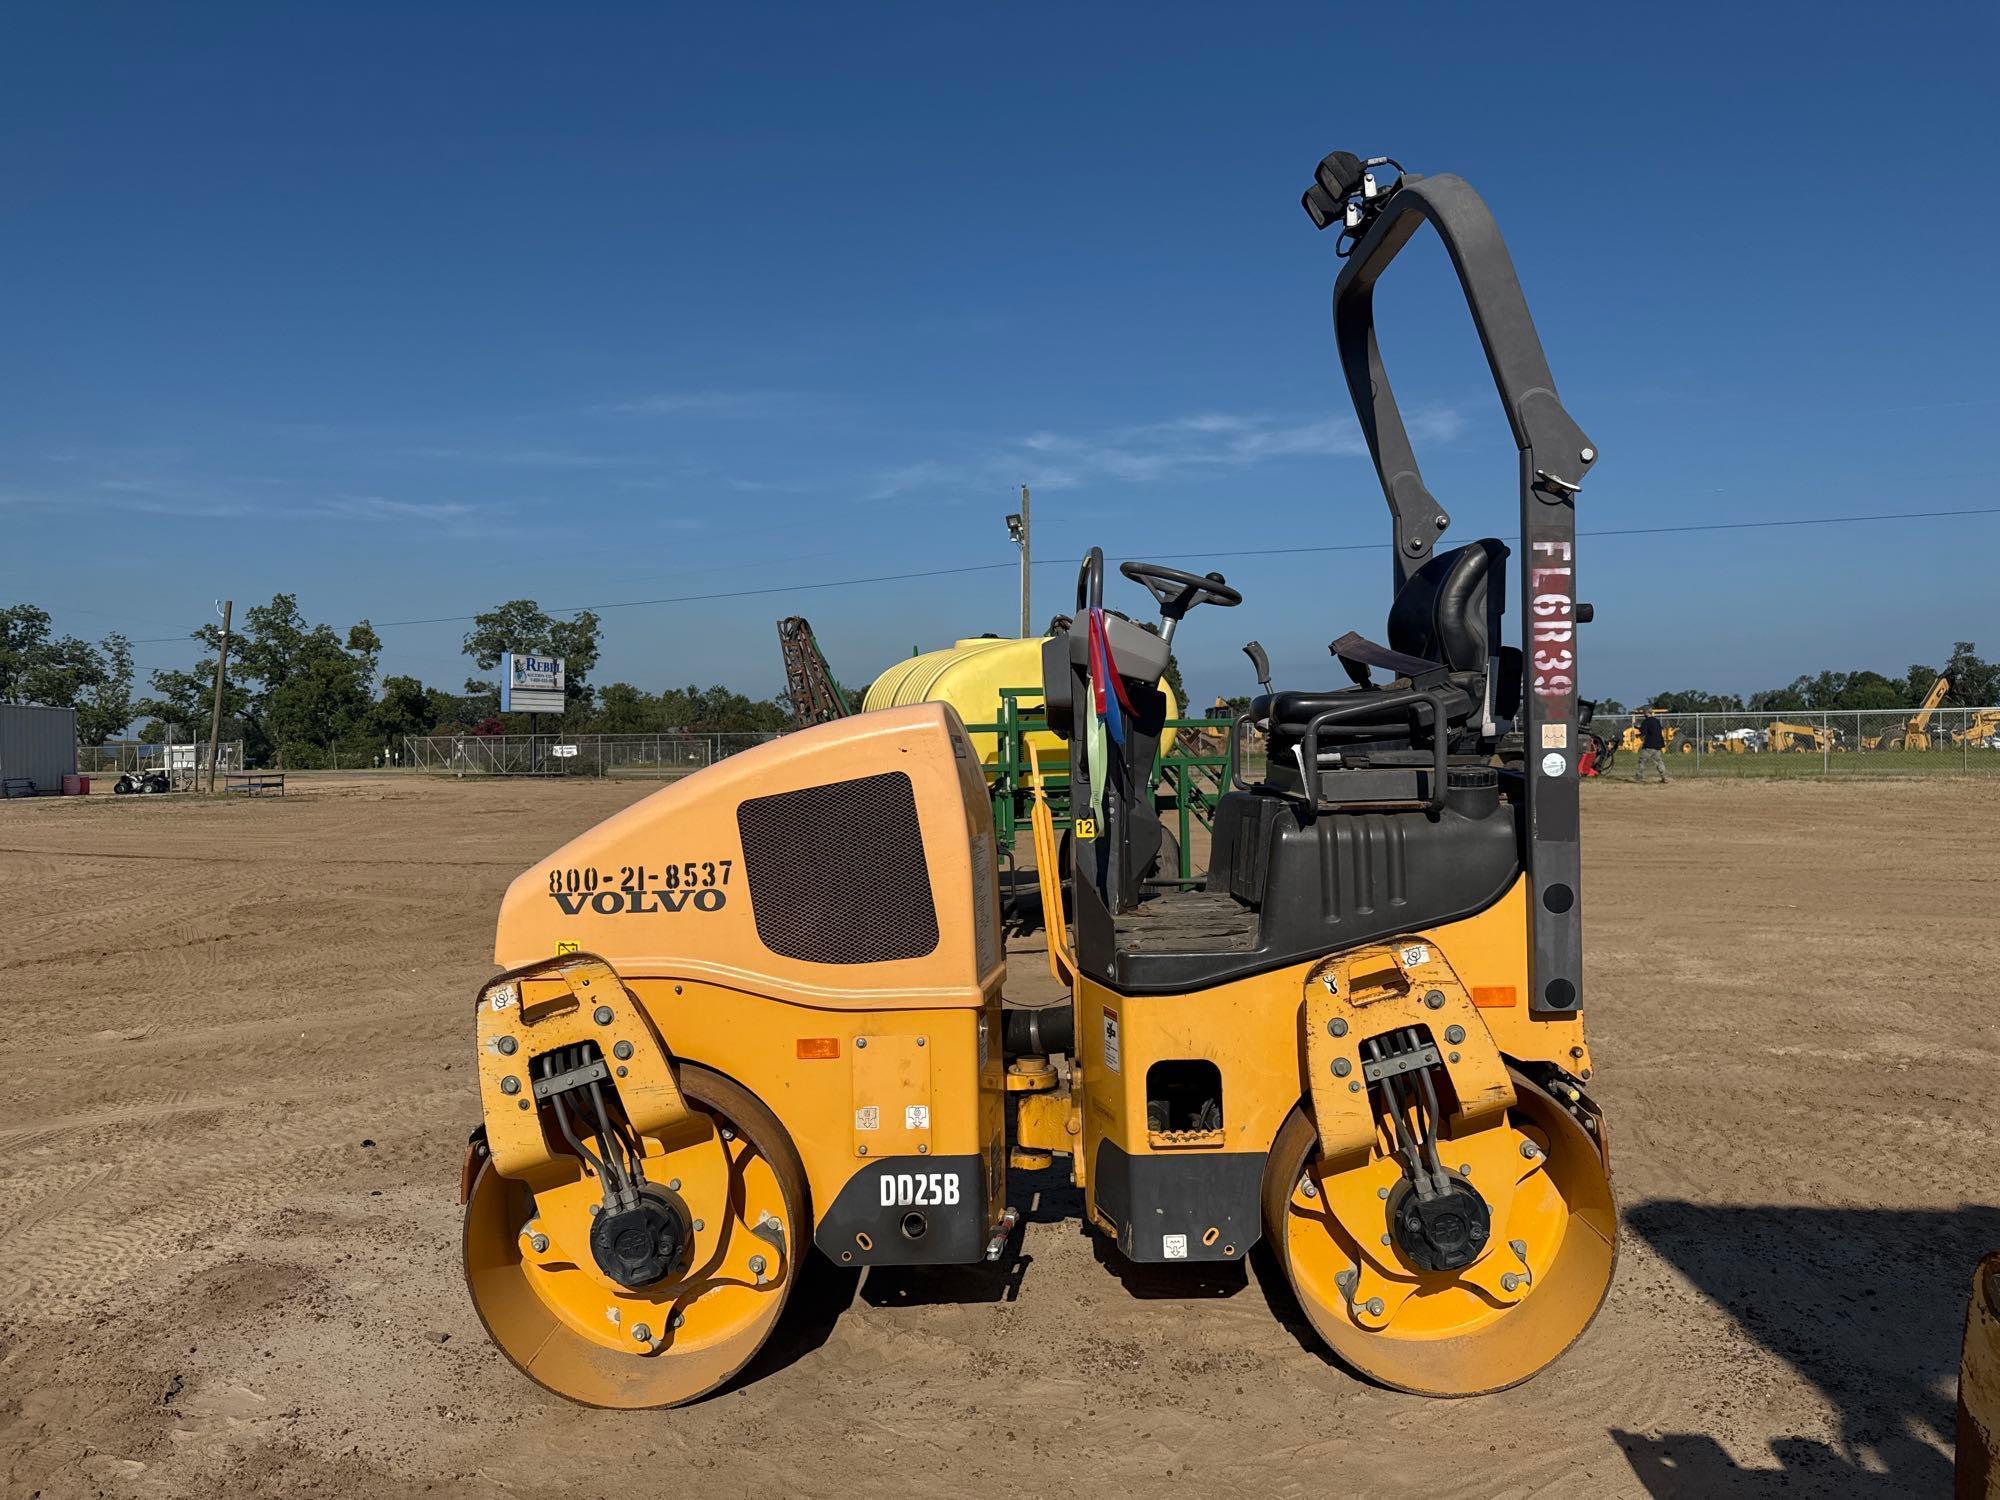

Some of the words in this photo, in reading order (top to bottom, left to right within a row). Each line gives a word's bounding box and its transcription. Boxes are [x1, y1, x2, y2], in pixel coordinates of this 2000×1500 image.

[1532, 541, 1573, 697] FL6R39
[1077, 820, 1093, 834] 12
[549, 860, 732, 893] 800-21-8537
[549, 889, 726, 915] VOLVO
[880, 1173, 960, 1206] DD25B
